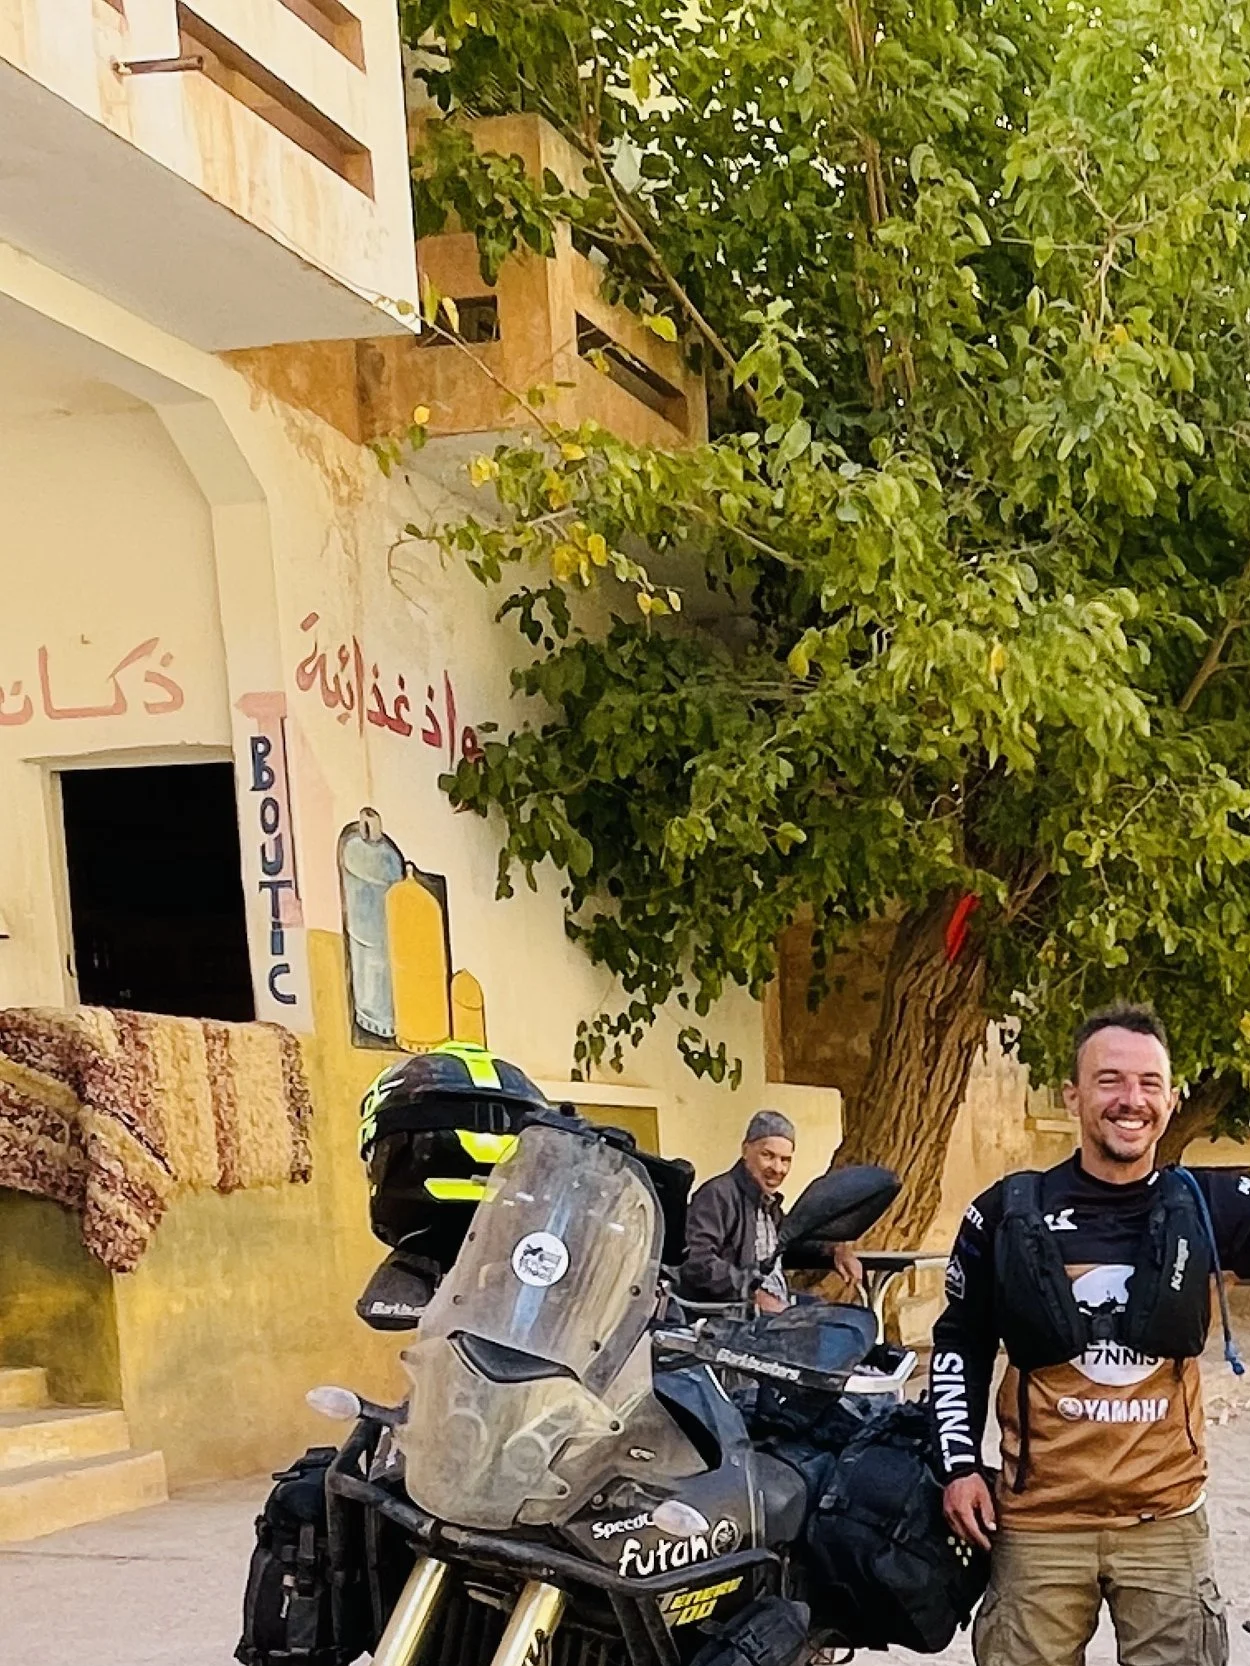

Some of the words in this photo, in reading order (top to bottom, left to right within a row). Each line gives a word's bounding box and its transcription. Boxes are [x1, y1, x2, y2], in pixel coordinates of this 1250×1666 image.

[250, 735, 297, 1005] BOUTIC
[933, 1352, 976, 1473] T7NNIS
[1083, 1397, 1169, 1422] YAMAHA
